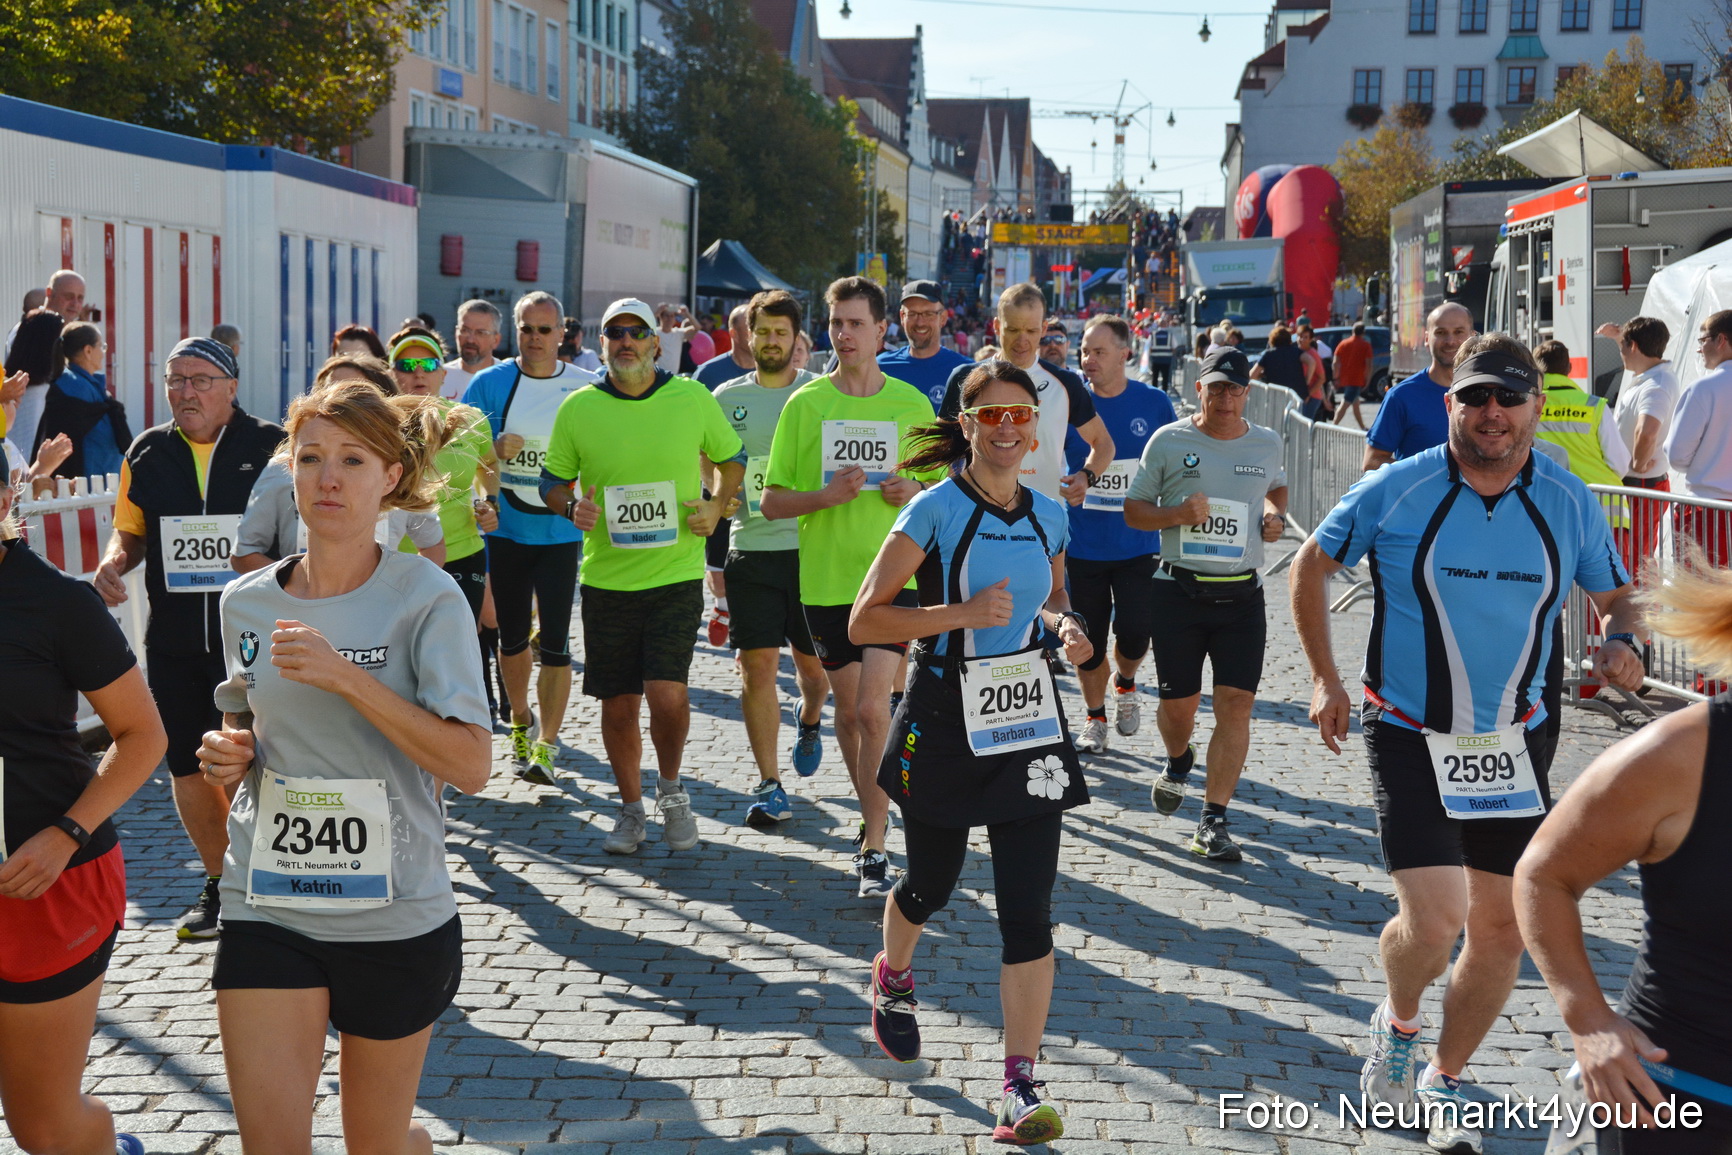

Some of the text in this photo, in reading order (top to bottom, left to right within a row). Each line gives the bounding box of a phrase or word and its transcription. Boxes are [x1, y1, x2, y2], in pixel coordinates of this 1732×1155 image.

[1036, 228, 1084, 240] START
[845, 426, 876, 436] BOCK
[834, 440, 887, 462] 2005
[1234, 465, 1265, 476] BOCK
[625, 489, 656, 498] BOCK
[1101, 498, 1122, 506] Stefan
[1209, 504, 1231, 512] OCK
[617, 500, 667, 523] 2004
[182, 523, 218, 531] BOCK
[632, 533, 657, 542] Nader
[173, 537, 231, 560] 2360
[1204, 545, 1218, 554] Ulli
[190, 574, 215, 584] Hans
[338, 646, 388, 664] OCK
[991, 662, 1031, 678] BOCK
[979, 678, 1043, 715] 2094
[1005, 713, 1031, 722] Neumarkt
[992, 727, 1035, 743] Barbara
[1456, 735, 1501, 747] BOCK
[1443, 752, 1515, 783] 2599
[286, 790, 344, 806] BOCK
[1469, 798, 1509, 809] Robert
[271, 813, 367, 855] 2340
[277, 859, 347, 869] PARTL Neumarkt
[291, 879, 342, 894] Katrin
